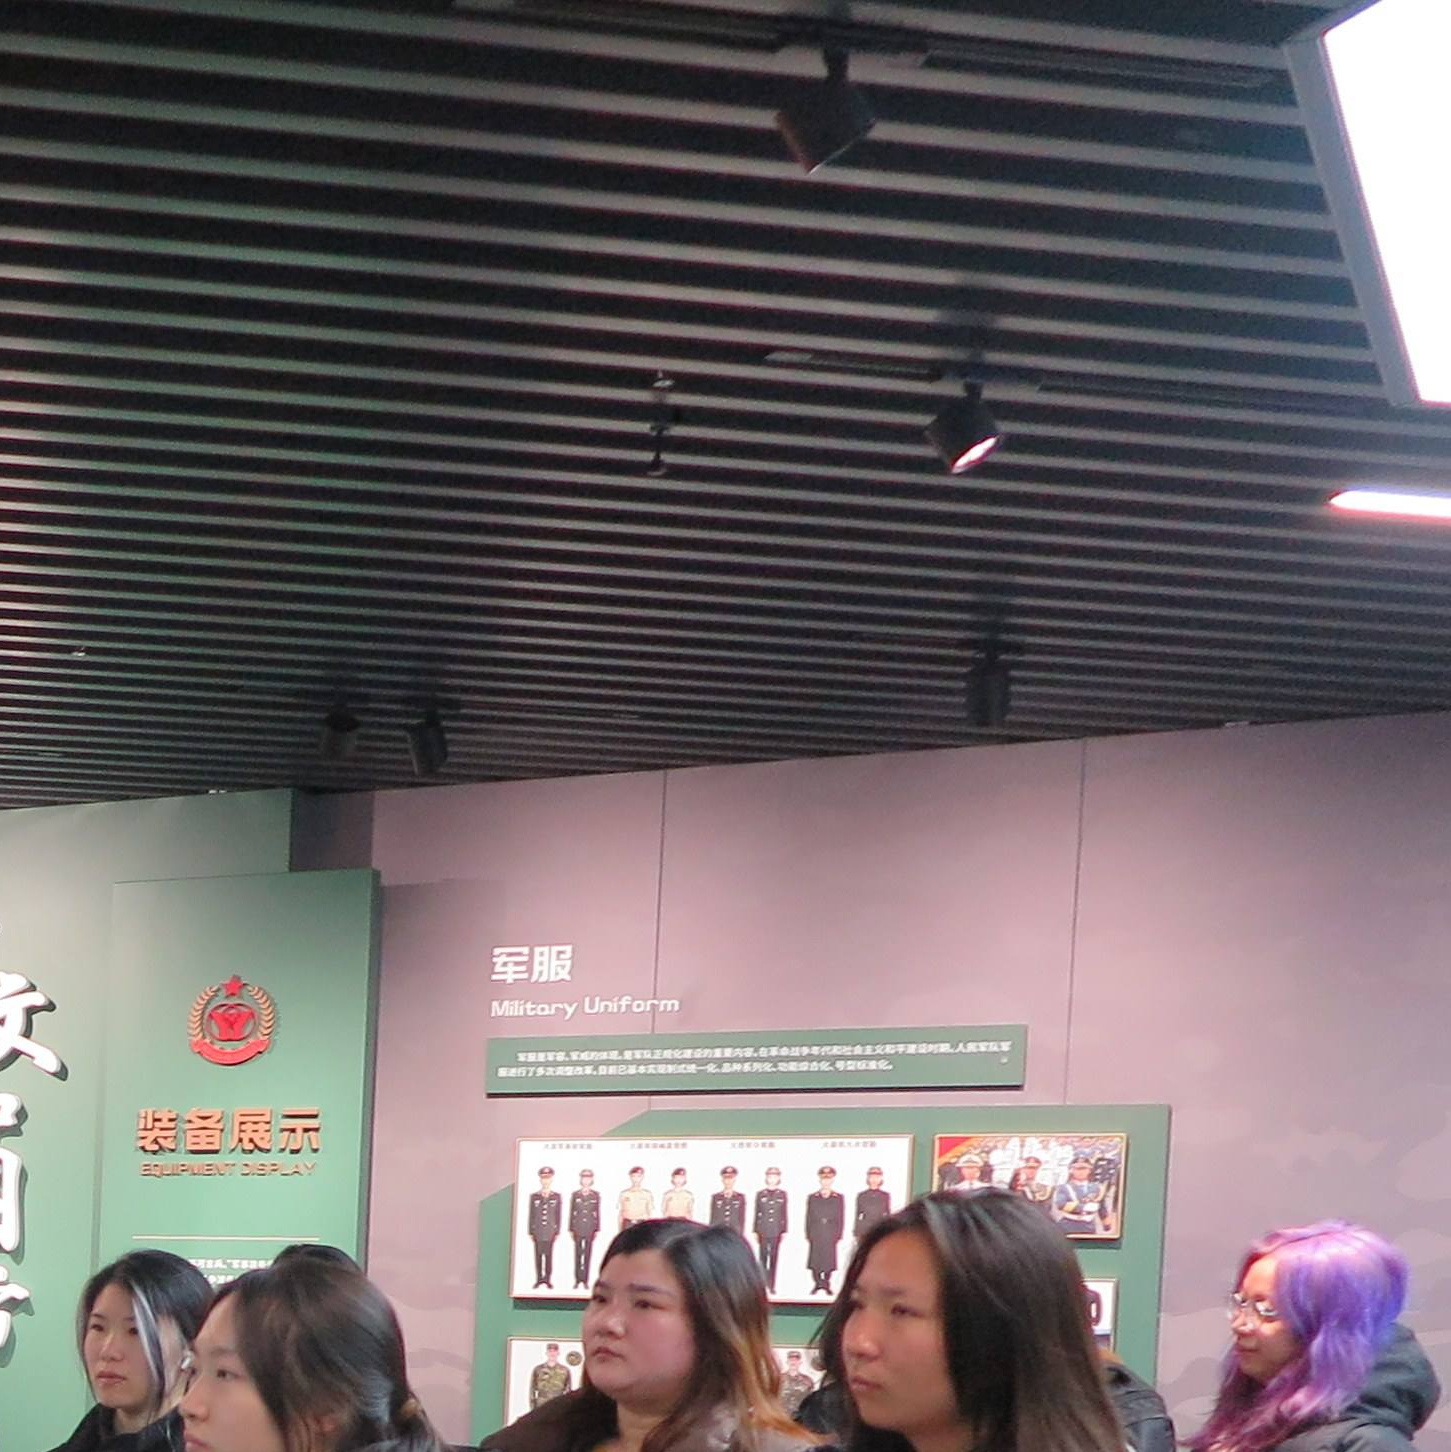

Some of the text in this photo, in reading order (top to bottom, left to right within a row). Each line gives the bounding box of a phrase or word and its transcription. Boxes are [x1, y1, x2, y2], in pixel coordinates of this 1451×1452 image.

[491, 944, 573, 984] 军服
[490, 995, 681, 1021] Military Uniform
[137, 1108, 320, 1154] 装备展示
[140, 1162, 317, 1177] EQUIPMENT DISPLAY
